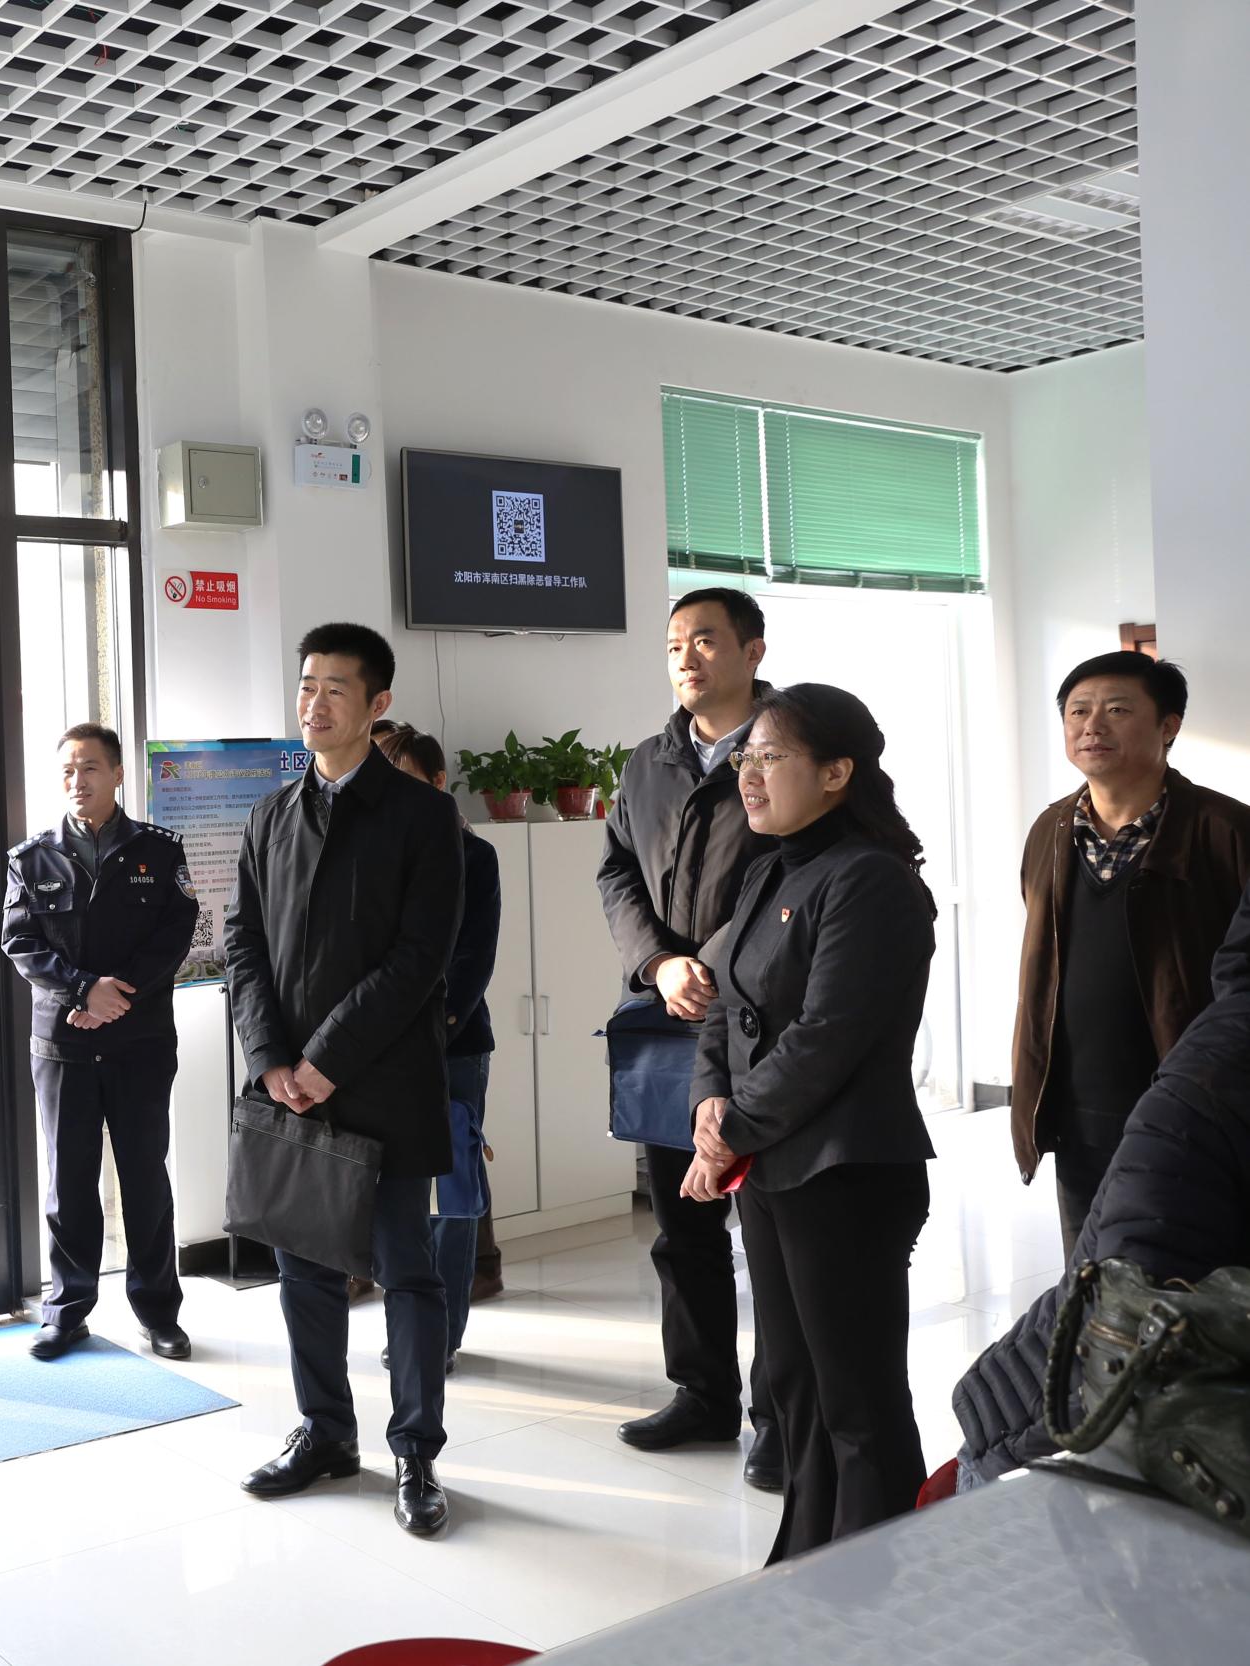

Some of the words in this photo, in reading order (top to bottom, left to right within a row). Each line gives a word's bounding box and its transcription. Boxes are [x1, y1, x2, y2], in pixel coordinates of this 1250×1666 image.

[195, 579, 236, 593] 禁止吸烟
[453, 570, 588, 588] 沈阳市浑南区扫黑除恶督导工作队
[195, 595, 206, 603] No
[206, 595, 237, 605] Smoking
